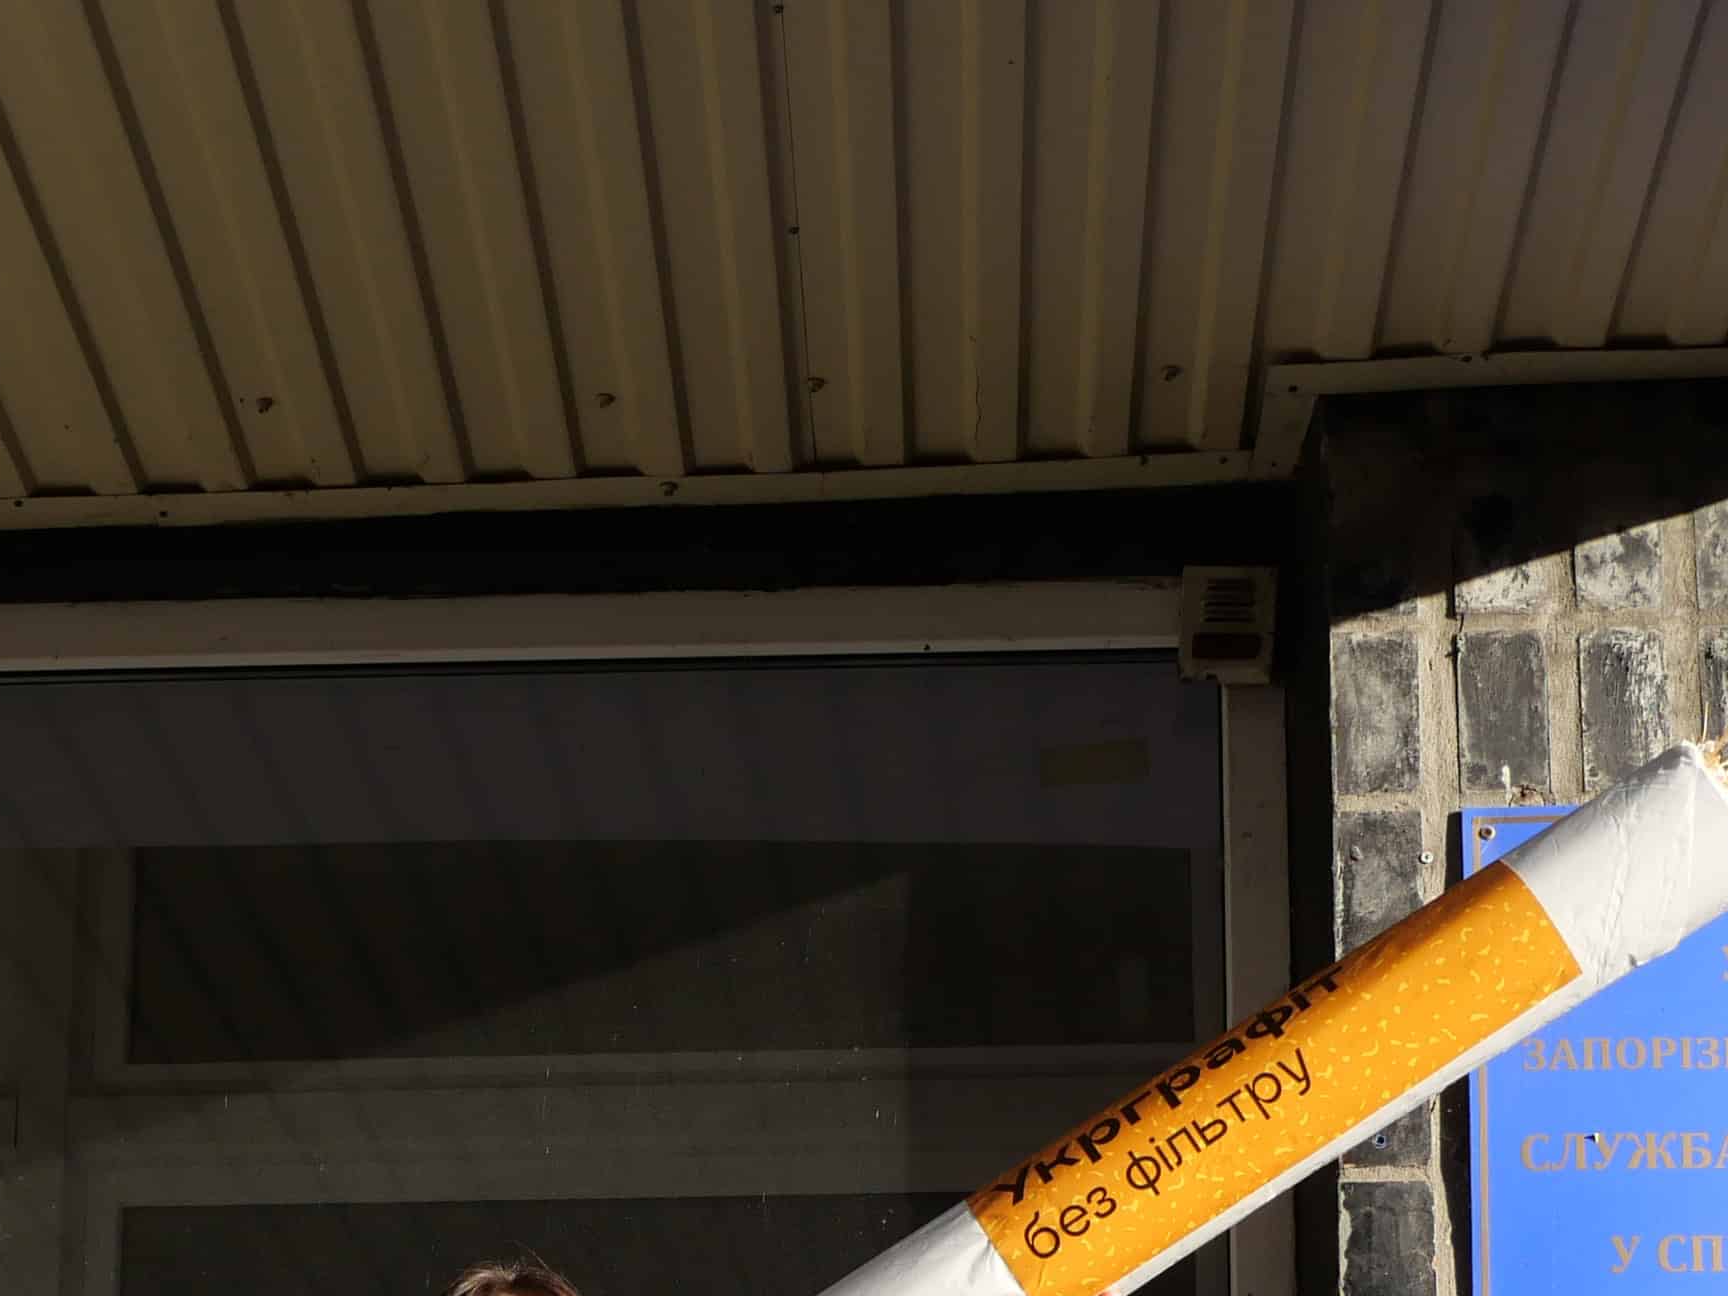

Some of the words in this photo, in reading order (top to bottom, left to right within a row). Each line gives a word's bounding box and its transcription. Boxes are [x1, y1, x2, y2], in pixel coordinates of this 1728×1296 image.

[989, 965, 1345, 1207] Укрграфіт
[1023, 1186, 1118, 1259] без
[1125, 1047, 1313, 1196] фільтру
[1609, 1235, 1641, 1275] У
